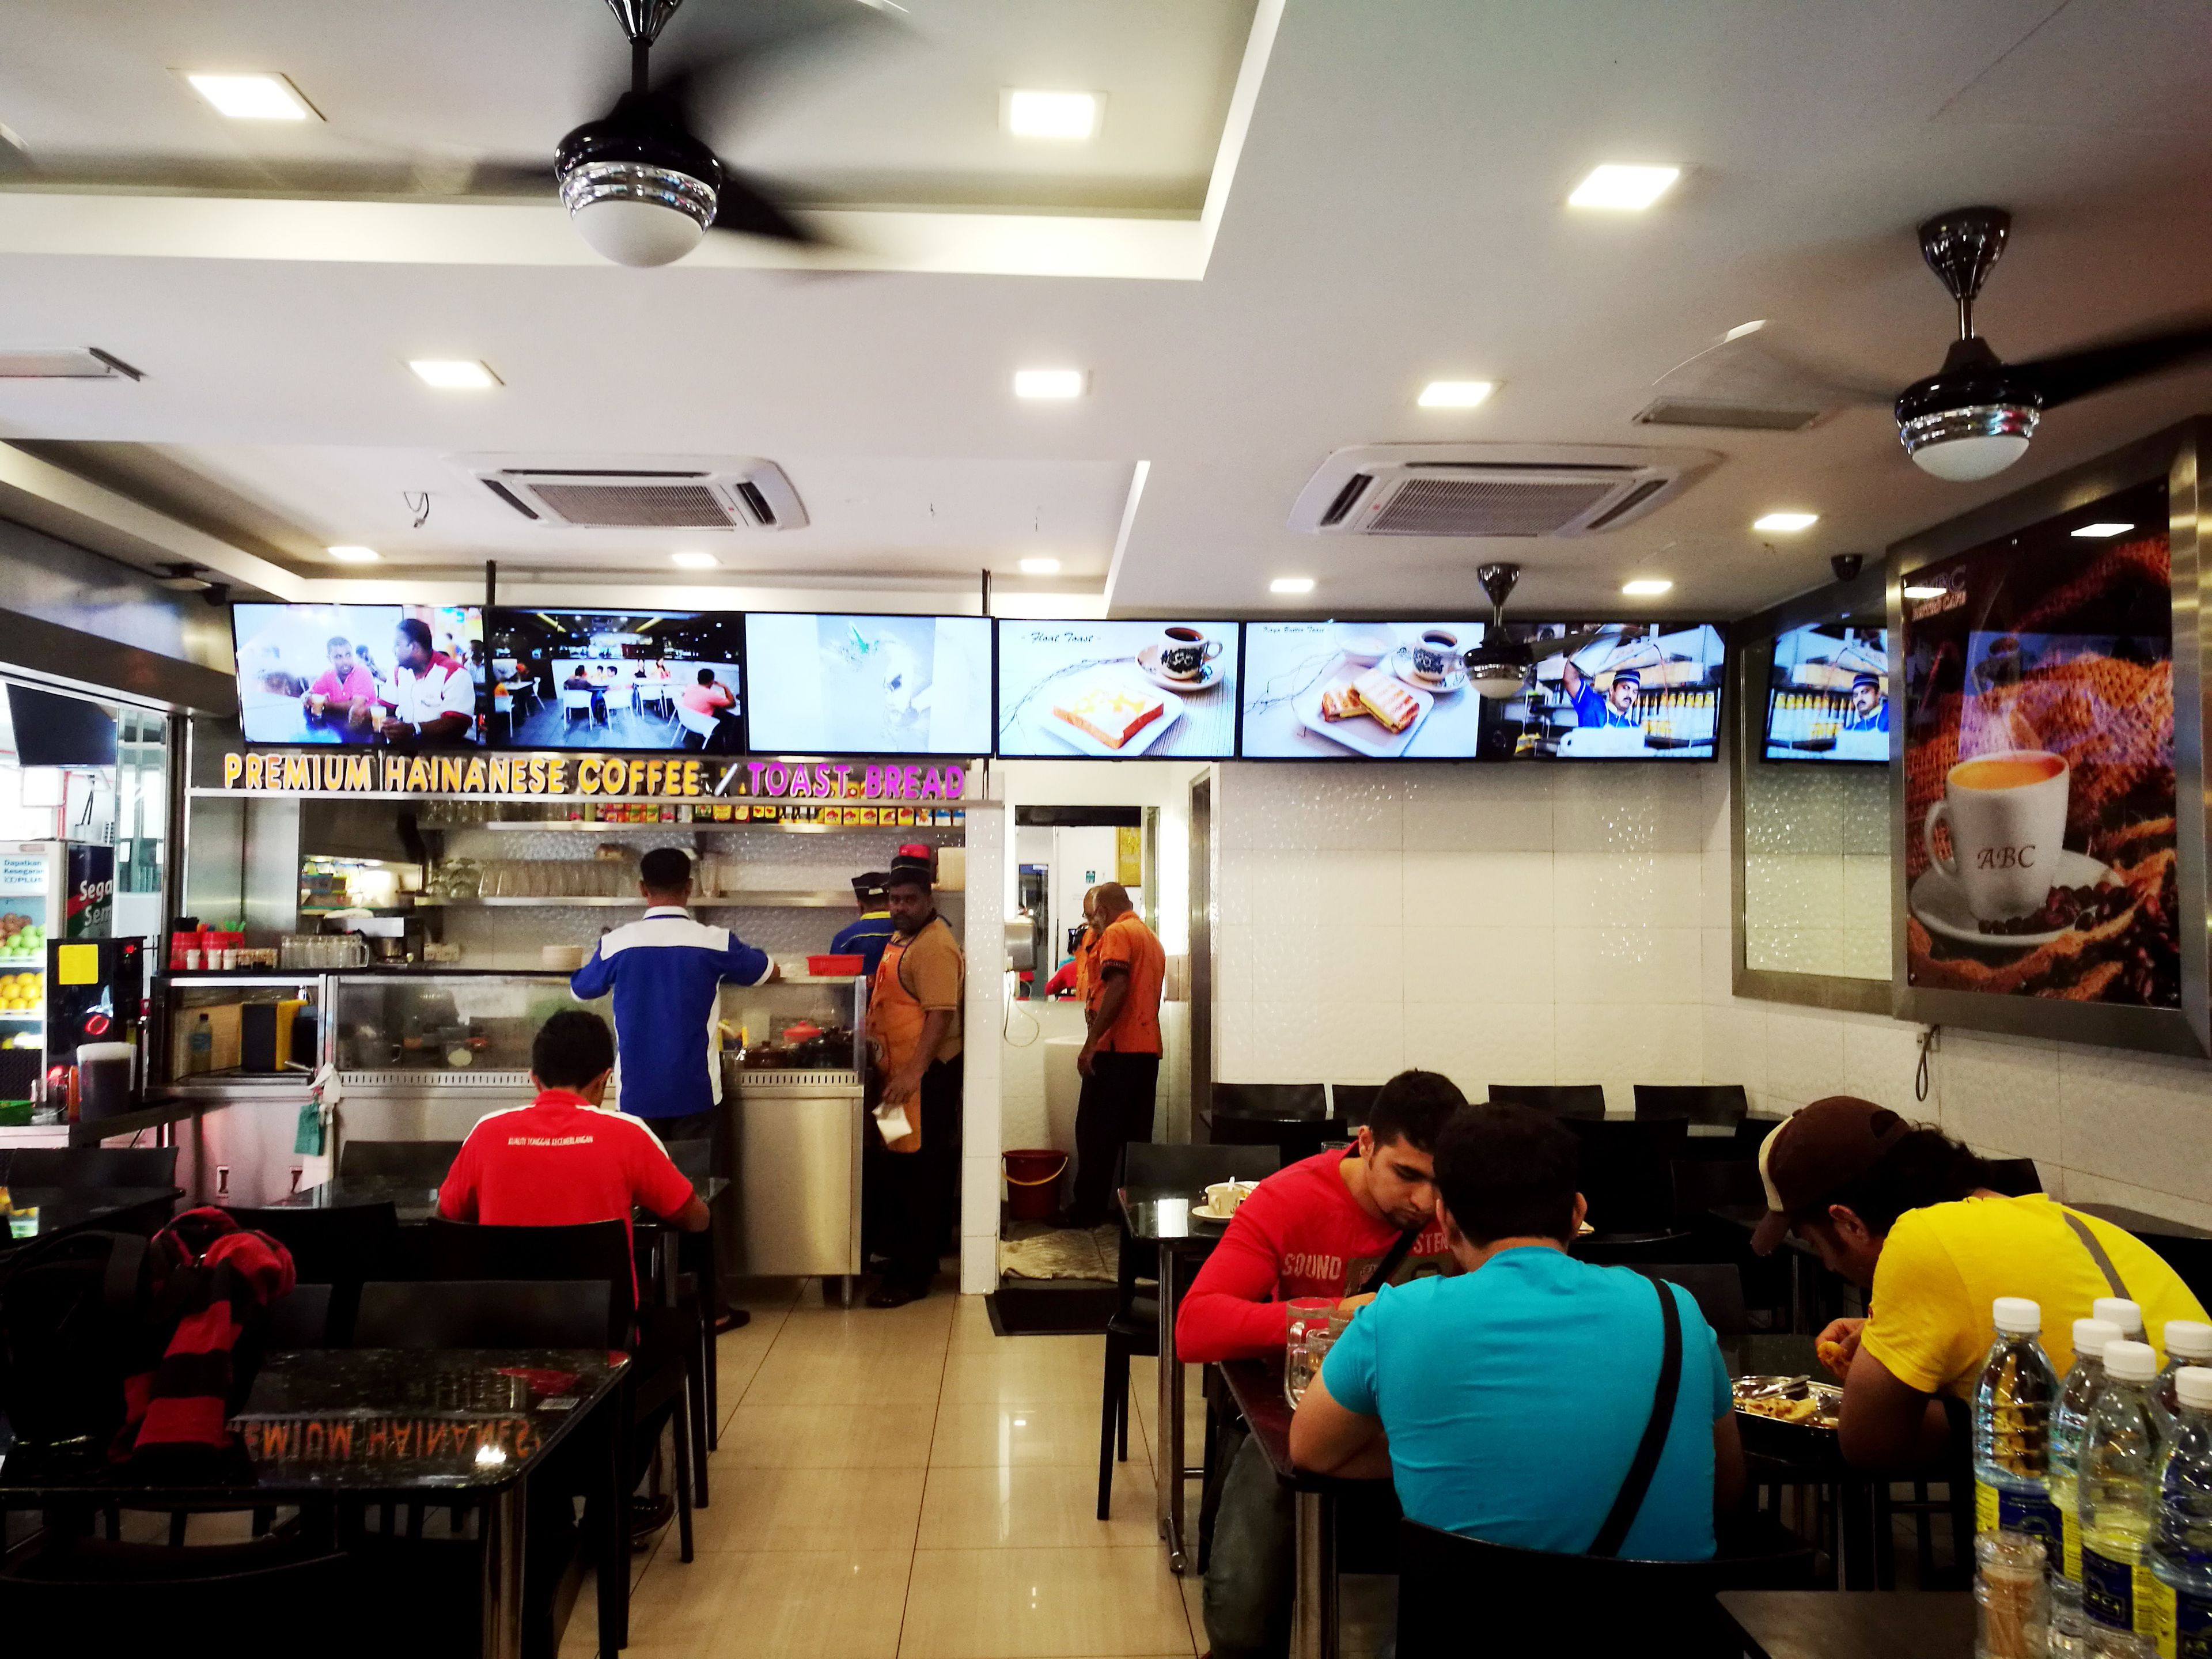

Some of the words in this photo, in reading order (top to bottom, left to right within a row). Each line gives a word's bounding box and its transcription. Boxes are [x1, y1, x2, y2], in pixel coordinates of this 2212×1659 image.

[224, 752, 372, 791] PREMIUM
[384, 755, 565, 794] HAINANESE
[578, 757, 700, 796] COFFEE
[748, 762, 850, 798] TOAST
[865, 764, 965, 800] BREAD
[1977, 845, 2036, 870] ABC
[1282, 1253, 1342, 1281] SOUND
